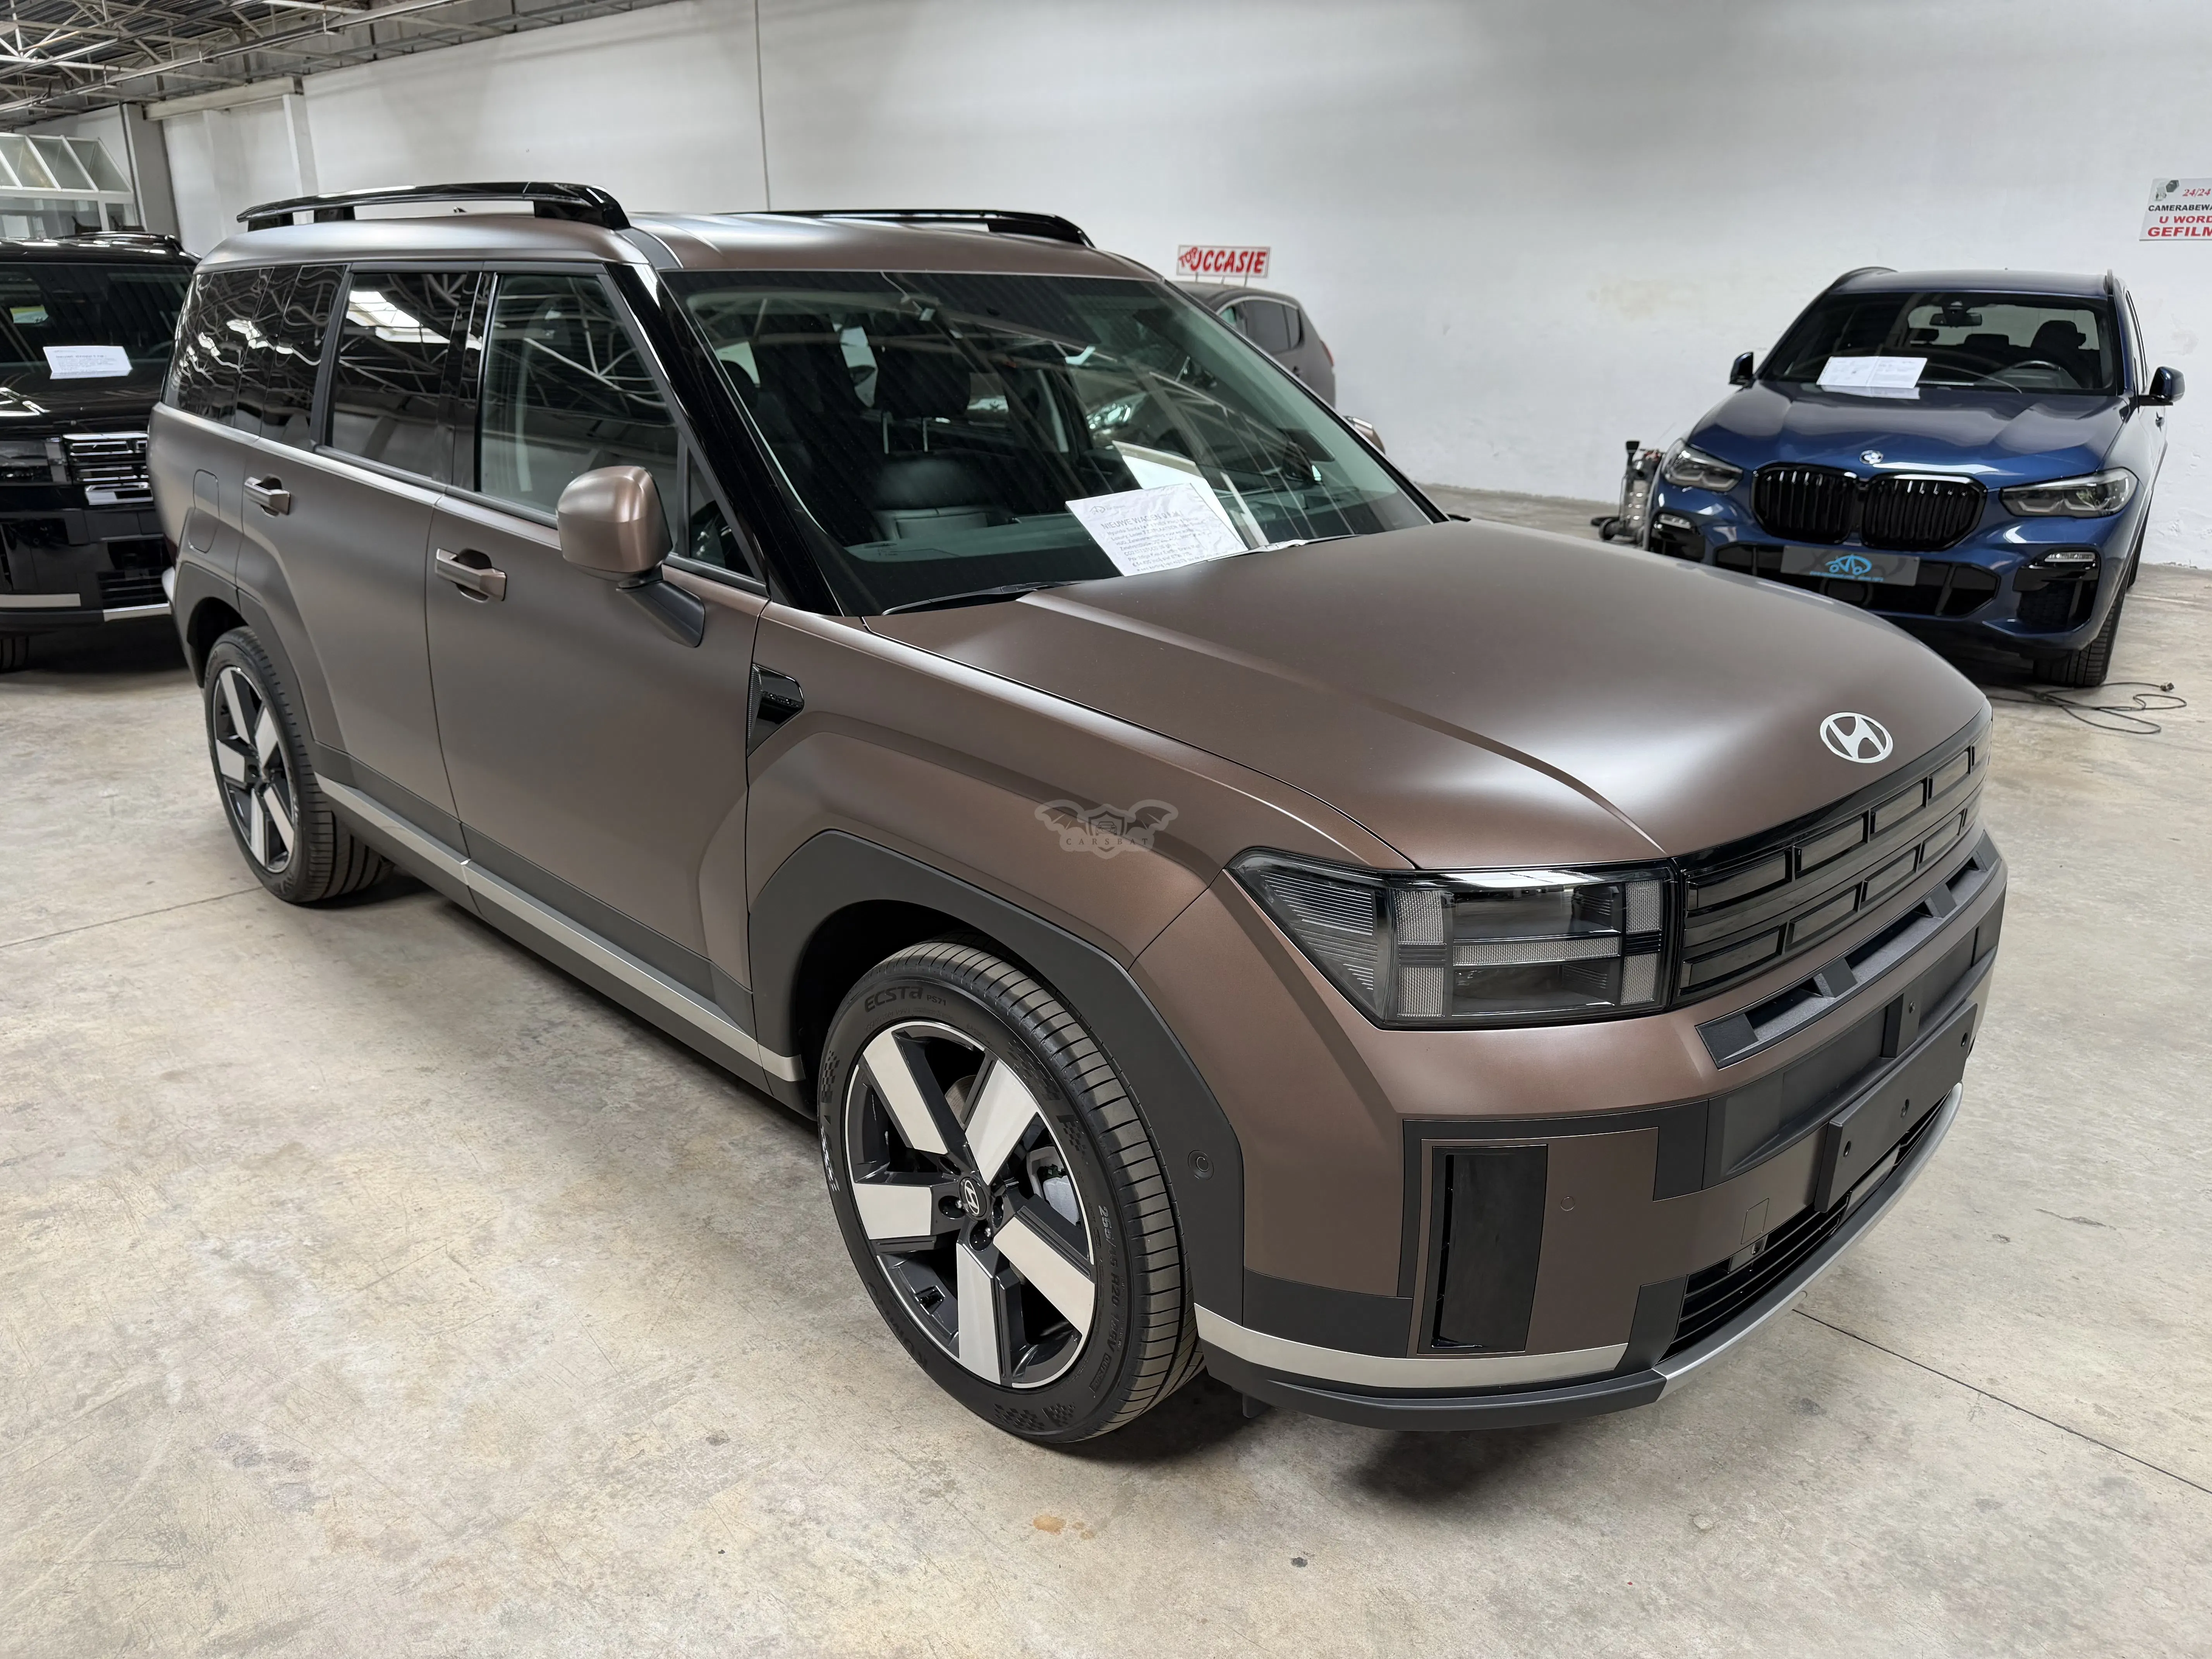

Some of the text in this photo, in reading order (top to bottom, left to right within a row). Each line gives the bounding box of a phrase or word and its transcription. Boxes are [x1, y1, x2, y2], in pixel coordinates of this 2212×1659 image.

[2182, 188, 2212, 198] 24/24
[1178, 246, 1198, 267] TOP
[1100, 519, 1133, 529] NIEUWE
[927, 994, 946, 1006] PS71
[1111, 1272, 1120, 1307] R20
